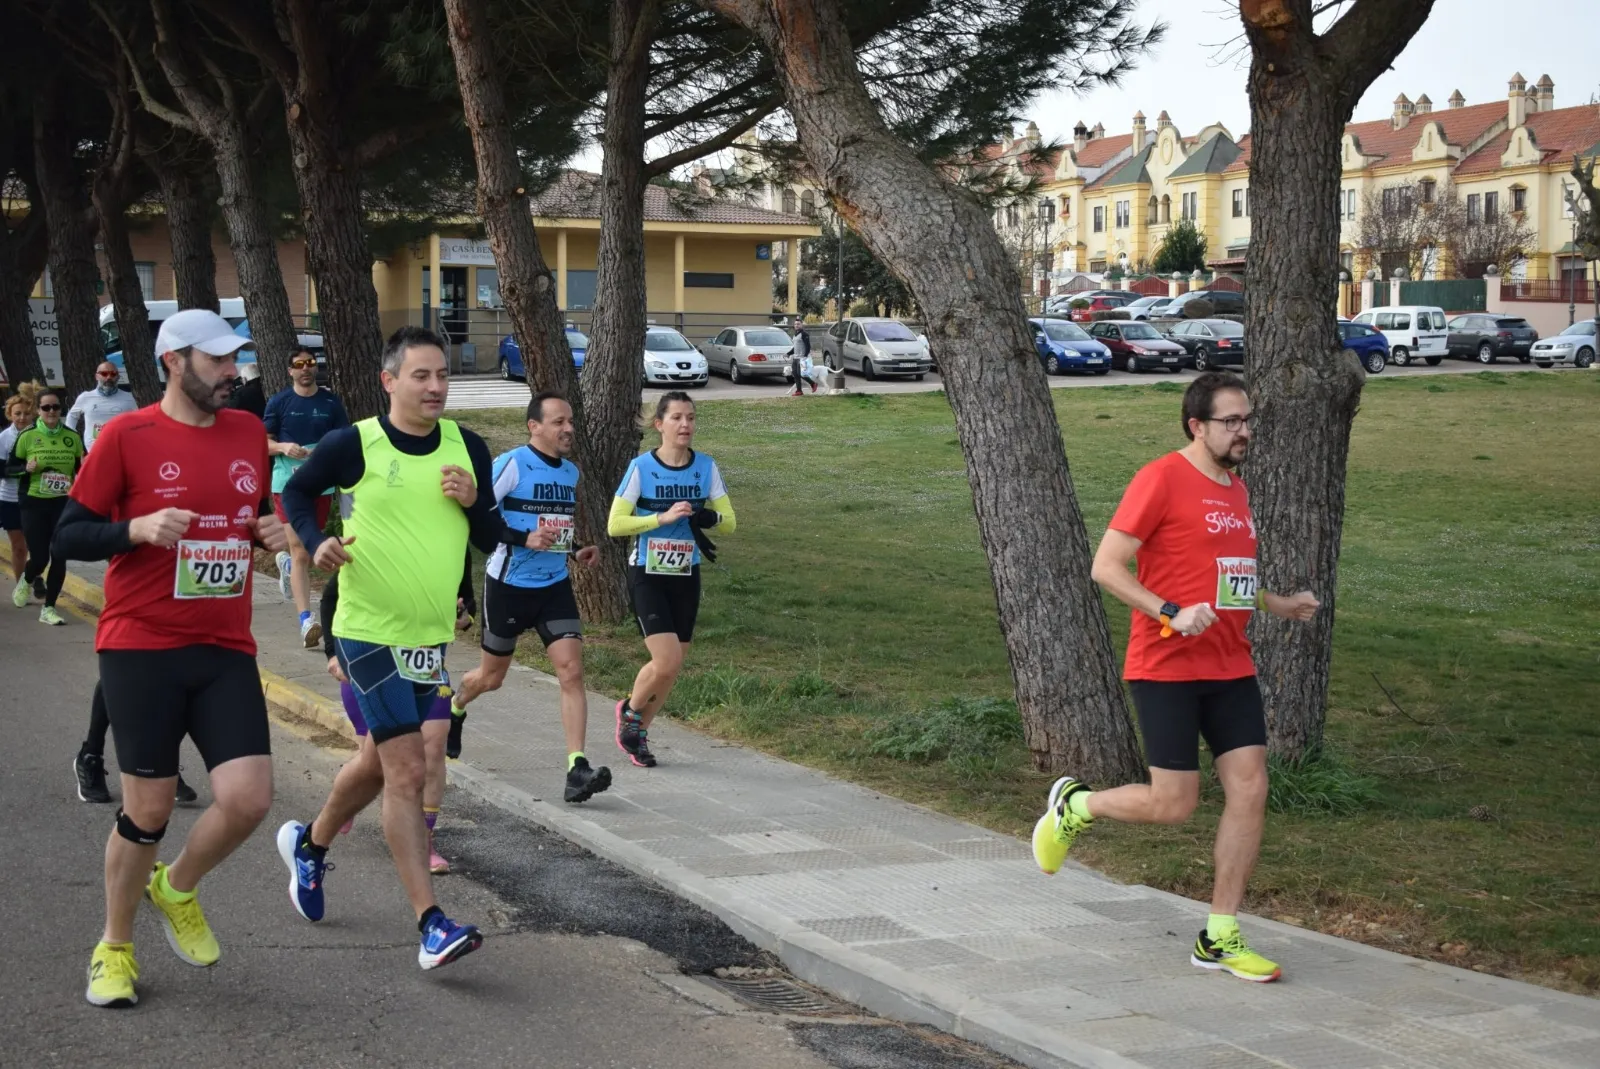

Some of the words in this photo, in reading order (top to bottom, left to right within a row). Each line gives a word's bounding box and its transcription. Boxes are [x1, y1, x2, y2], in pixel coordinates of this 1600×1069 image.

[452, 245, 475, 253] CASA
[48, 480, 66, 490] 782
[655, 481, 702, 498] naturé
[522, 504, 552, 513] centro
[553, 505, 563, 513] de
[1205, 511, 1244, 535] gijón
[657, 552, 686, 566] 747
[194, 562, 237, 584] 703
[401, 649, 434, 670] 705
